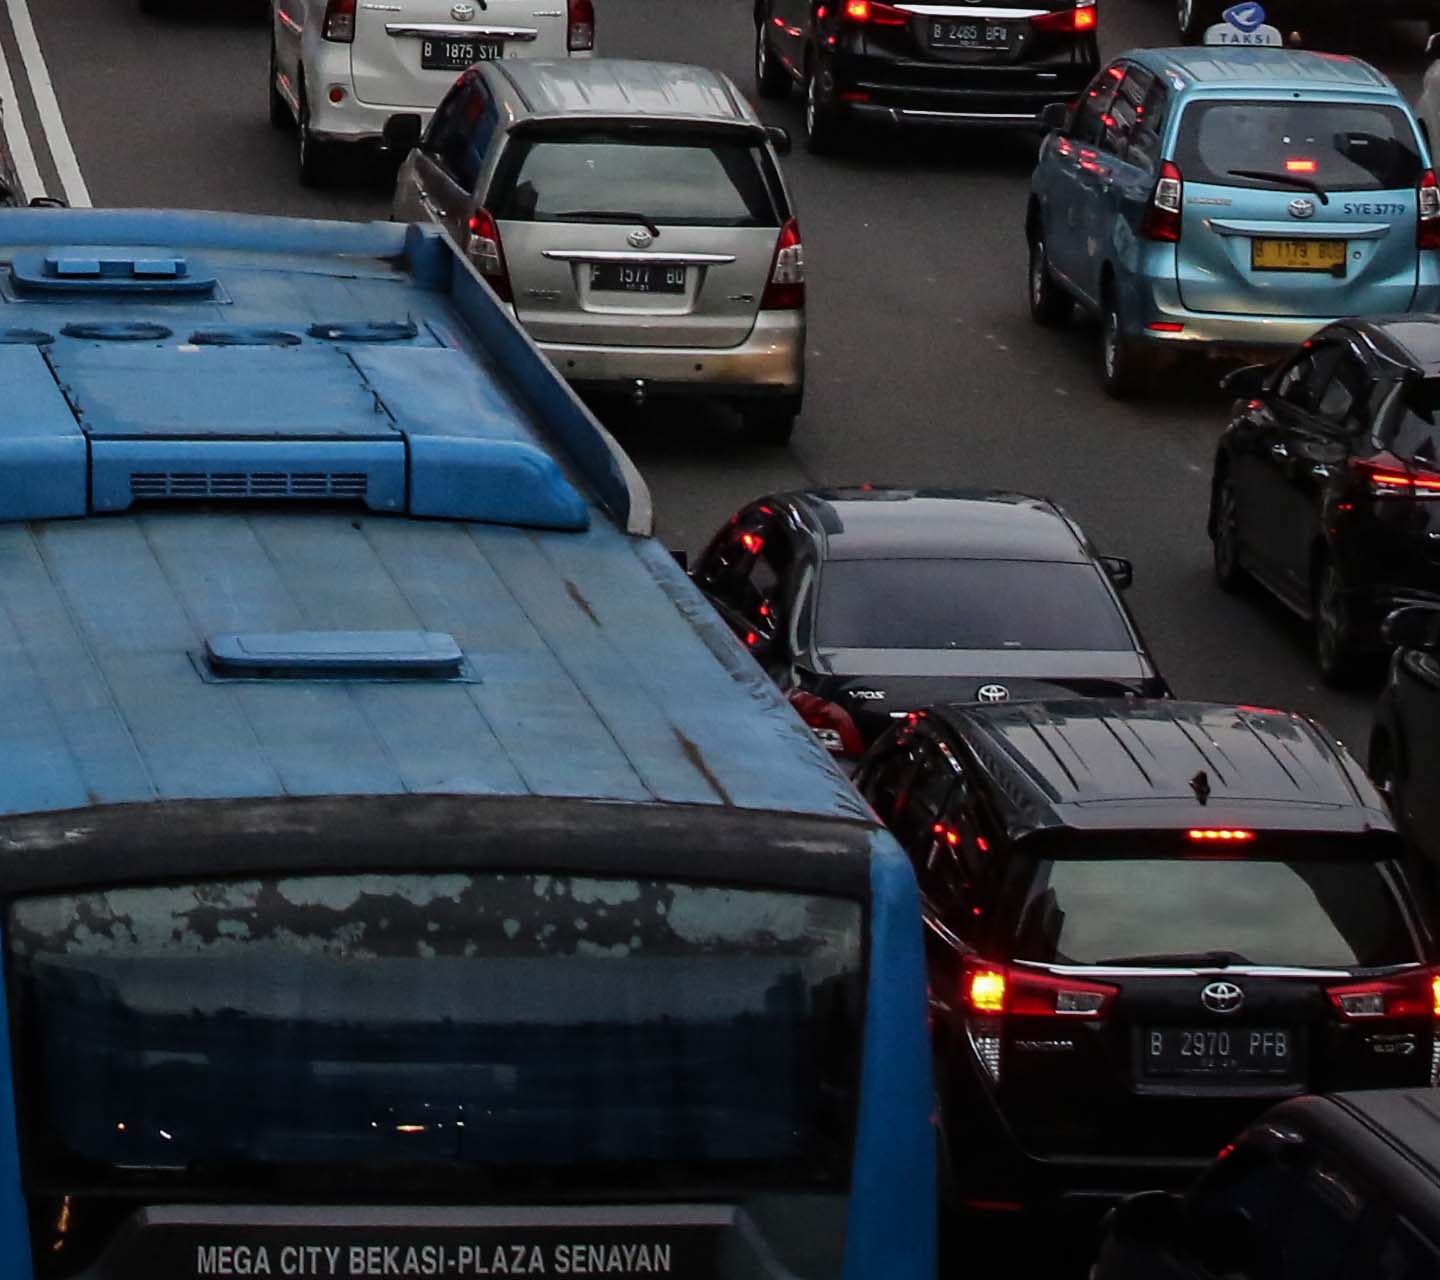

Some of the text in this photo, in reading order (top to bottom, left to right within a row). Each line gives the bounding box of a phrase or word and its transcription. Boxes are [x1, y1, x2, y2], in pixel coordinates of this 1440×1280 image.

[933, 23, 942, 38] B
[1219, 32, 1271, 45] TAKSI
[423, 41, 432, 57] B
[445, 42, 473, 58] 1875
[1343, 202, 1407, 216] SYE 3779
[1150, 1032, 1287, 1057] B 2970 PFB
[199, 1244, 671, 1274] MEGA CITY BEKASI-PLAZA SENAYAN
